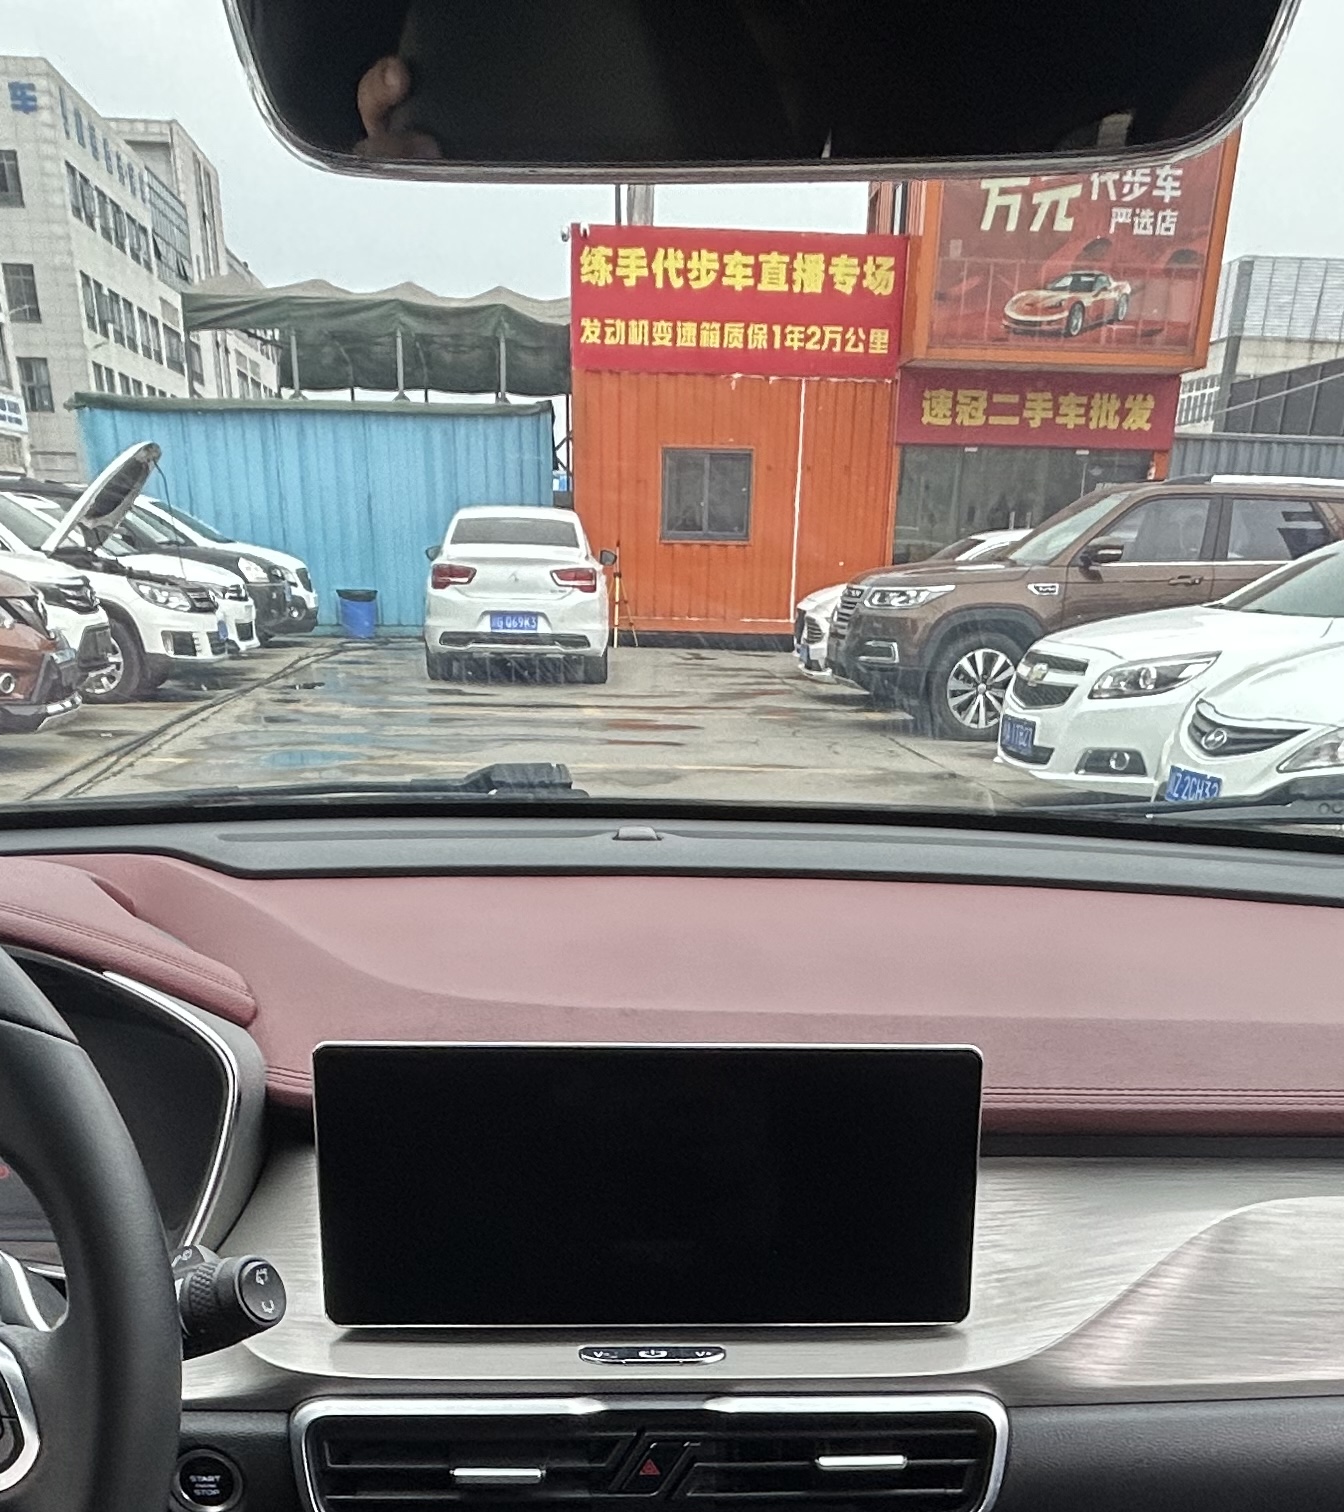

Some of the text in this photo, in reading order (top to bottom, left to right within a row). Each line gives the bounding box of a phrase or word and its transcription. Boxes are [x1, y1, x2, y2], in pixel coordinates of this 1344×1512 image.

[1090, 165, 1184, 203] 代步车
[980, 176, 1083, 233] 万元
[1109, 206, 1178, 237] 严选店
[579, 244, 896, 296] 练手代步车直播专场
[579, 317, 890, 356] 发动机变速箱质保1年2万公里
[920, 388, 1156, 432] 速冠二手车批发
[189, 1475, 221, 1483] START
